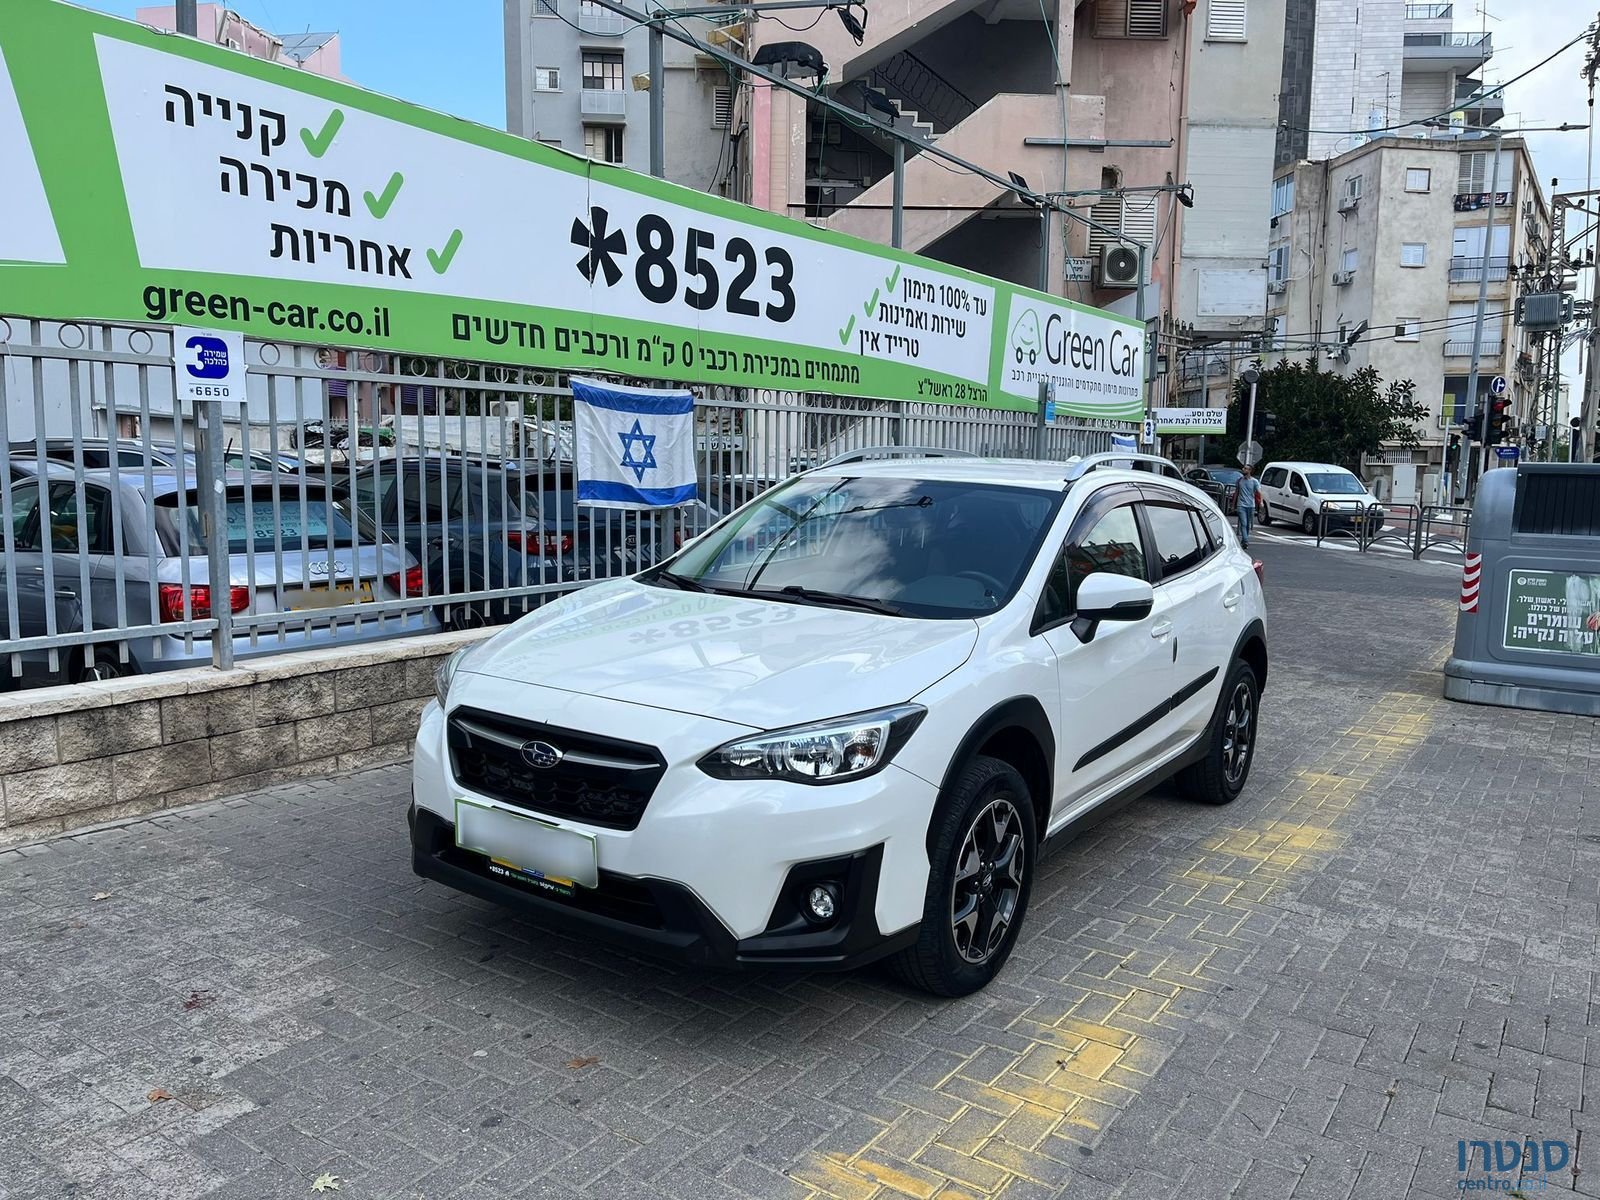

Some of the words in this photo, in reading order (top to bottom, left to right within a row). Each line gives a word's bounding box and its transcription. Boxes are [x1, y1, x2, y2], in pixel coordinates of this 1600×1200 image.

[164, 84, 287, 157] קנייה
[219, 156, 351, 217] מכירה
[270, 222, 413, 279] אחריות
[903, 277, 935, 303] מימון
[939, 285, 970, 312] 100%
[143, 285, 391, 338] green-car.co.il
[879, 302, 928, 330] ואמינות
[973, 297, 987, 317] עד
[452, 313, 545, 349] חדשים
[931, 314, 966, 338] שירות
[203, 350, 227, 358] שמירה
[555, 327, 630, 361] ורכבים
[682, 341, 694, 368] 0
[859, 330, 880, 356] אין
[884, 334, 919, 358] טרייד
[1046, 313, 1105, 372] Green
[1109, 330, 1139, 378] Car
[204, 357, 227, 366] כהלכה
[699, 347, 738, 374] רכבי
[743, 351, 801, 378] במכירת
[805, 360, 860, 385] מתמחים
[918, 378, 952, 398] ראשל"צ
[1011, 369, 1025, 382] רכב
[954, 383, 966, 399] 28
[967, 385, 988, 402] הרצל
[1175, 417, 1190, 426] קצת
[1203, 417, 1222, 425] אצלנו
[1206, 410, 1223, 418] שלם
[1512, 625, 1555, 642] נקייה!
